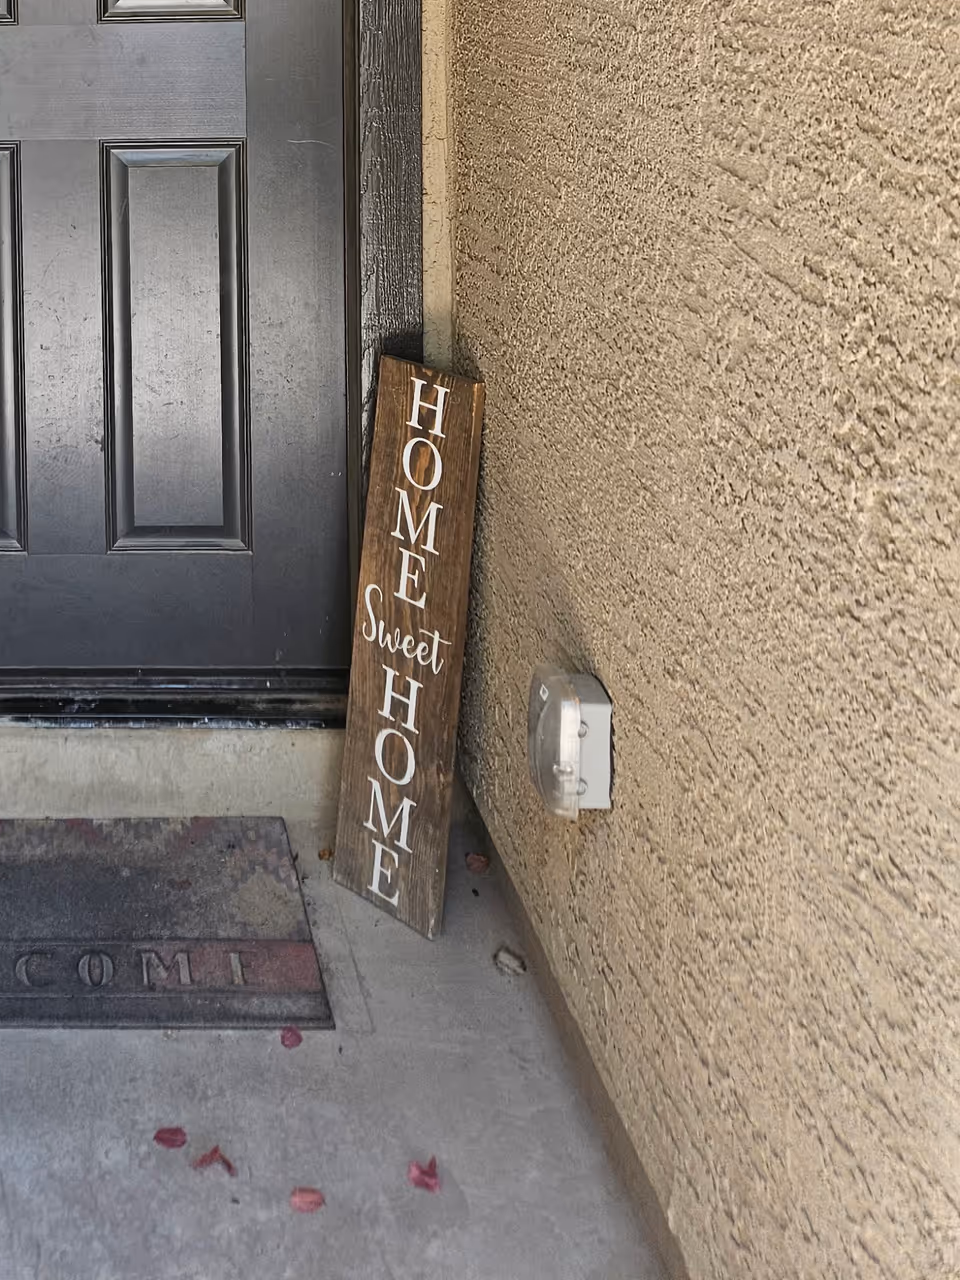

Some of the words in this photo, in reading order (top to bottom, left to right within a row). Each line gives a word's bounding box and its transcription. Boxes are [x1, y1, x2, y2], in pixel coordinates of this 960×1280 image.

[390, 376, 451, 610] HOME
[361, 583, 452, 675] Sweet
[363, 663, 424, 907] HOME
